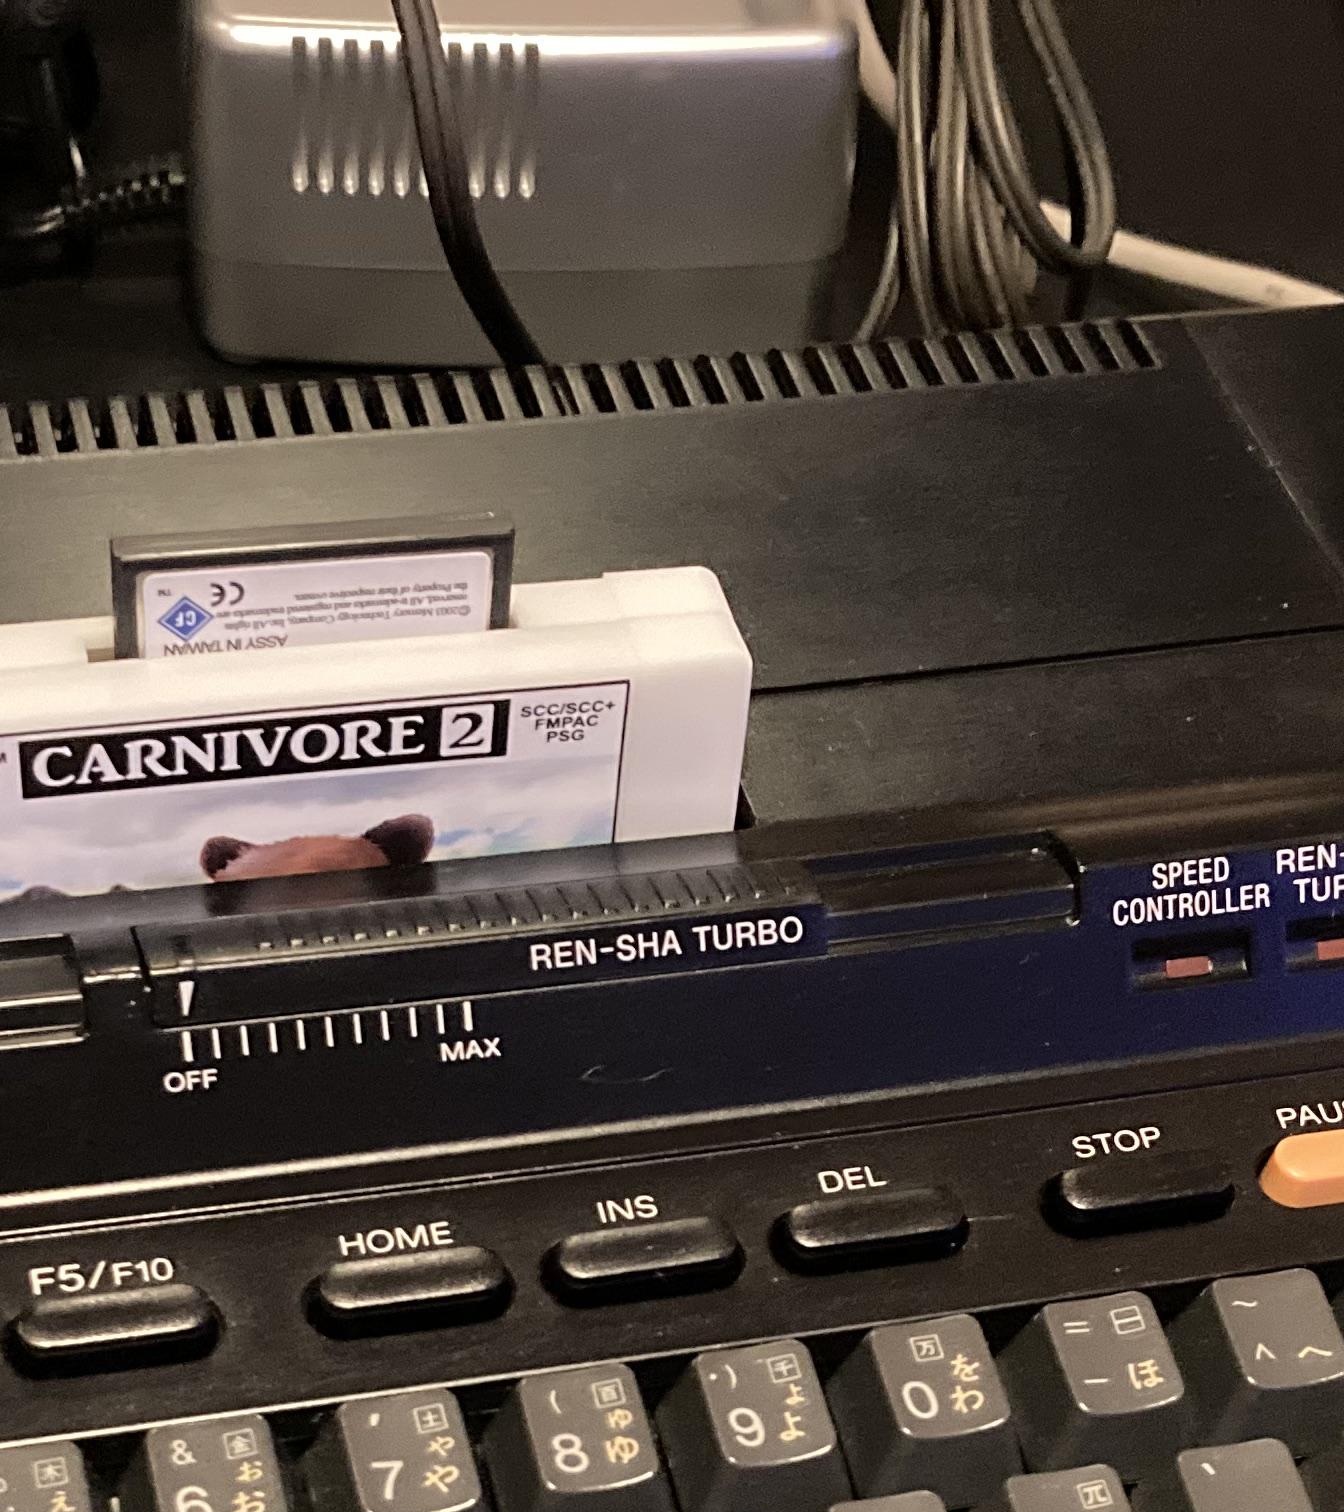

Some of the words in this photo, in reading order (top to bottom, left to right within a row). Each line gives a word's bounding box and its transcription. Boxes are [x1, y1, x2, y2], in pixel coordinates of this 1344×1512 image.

[519, 700, 615, 720] SCC/SCC+
[533, 713, 600, 733] FMPAC
[31, 718, 425, 790] CARNIVORE
[450, 712, 487, 751] 2
[545, 729, 585, 745] PSG
[1151, 857, 1231, 891] SPEED
[1112, 882, 1270, 928] CONTROLLER
[528, 926, 683, 973] REN-SHA
[693, 915, 803, 955] TURBO
[440, 1035, 501, 1064] MAX
[163, 1068, 218, 1094] OFF
[1072, 1126, 1162, 1159] STOP
[818, 1164, 886, 1196] DEL
[596, 1195, 658, 1227] INS
[338, 1221, 453, 1257] HOME
[29, 1256, 174, 1296] F5/F10
[902, 1381, 938, 1419] 0
[729, 1408, 765, 1447] 9
[552, 1433, 589, 1473] 8
[371, 1461, 403, 1500] 7
